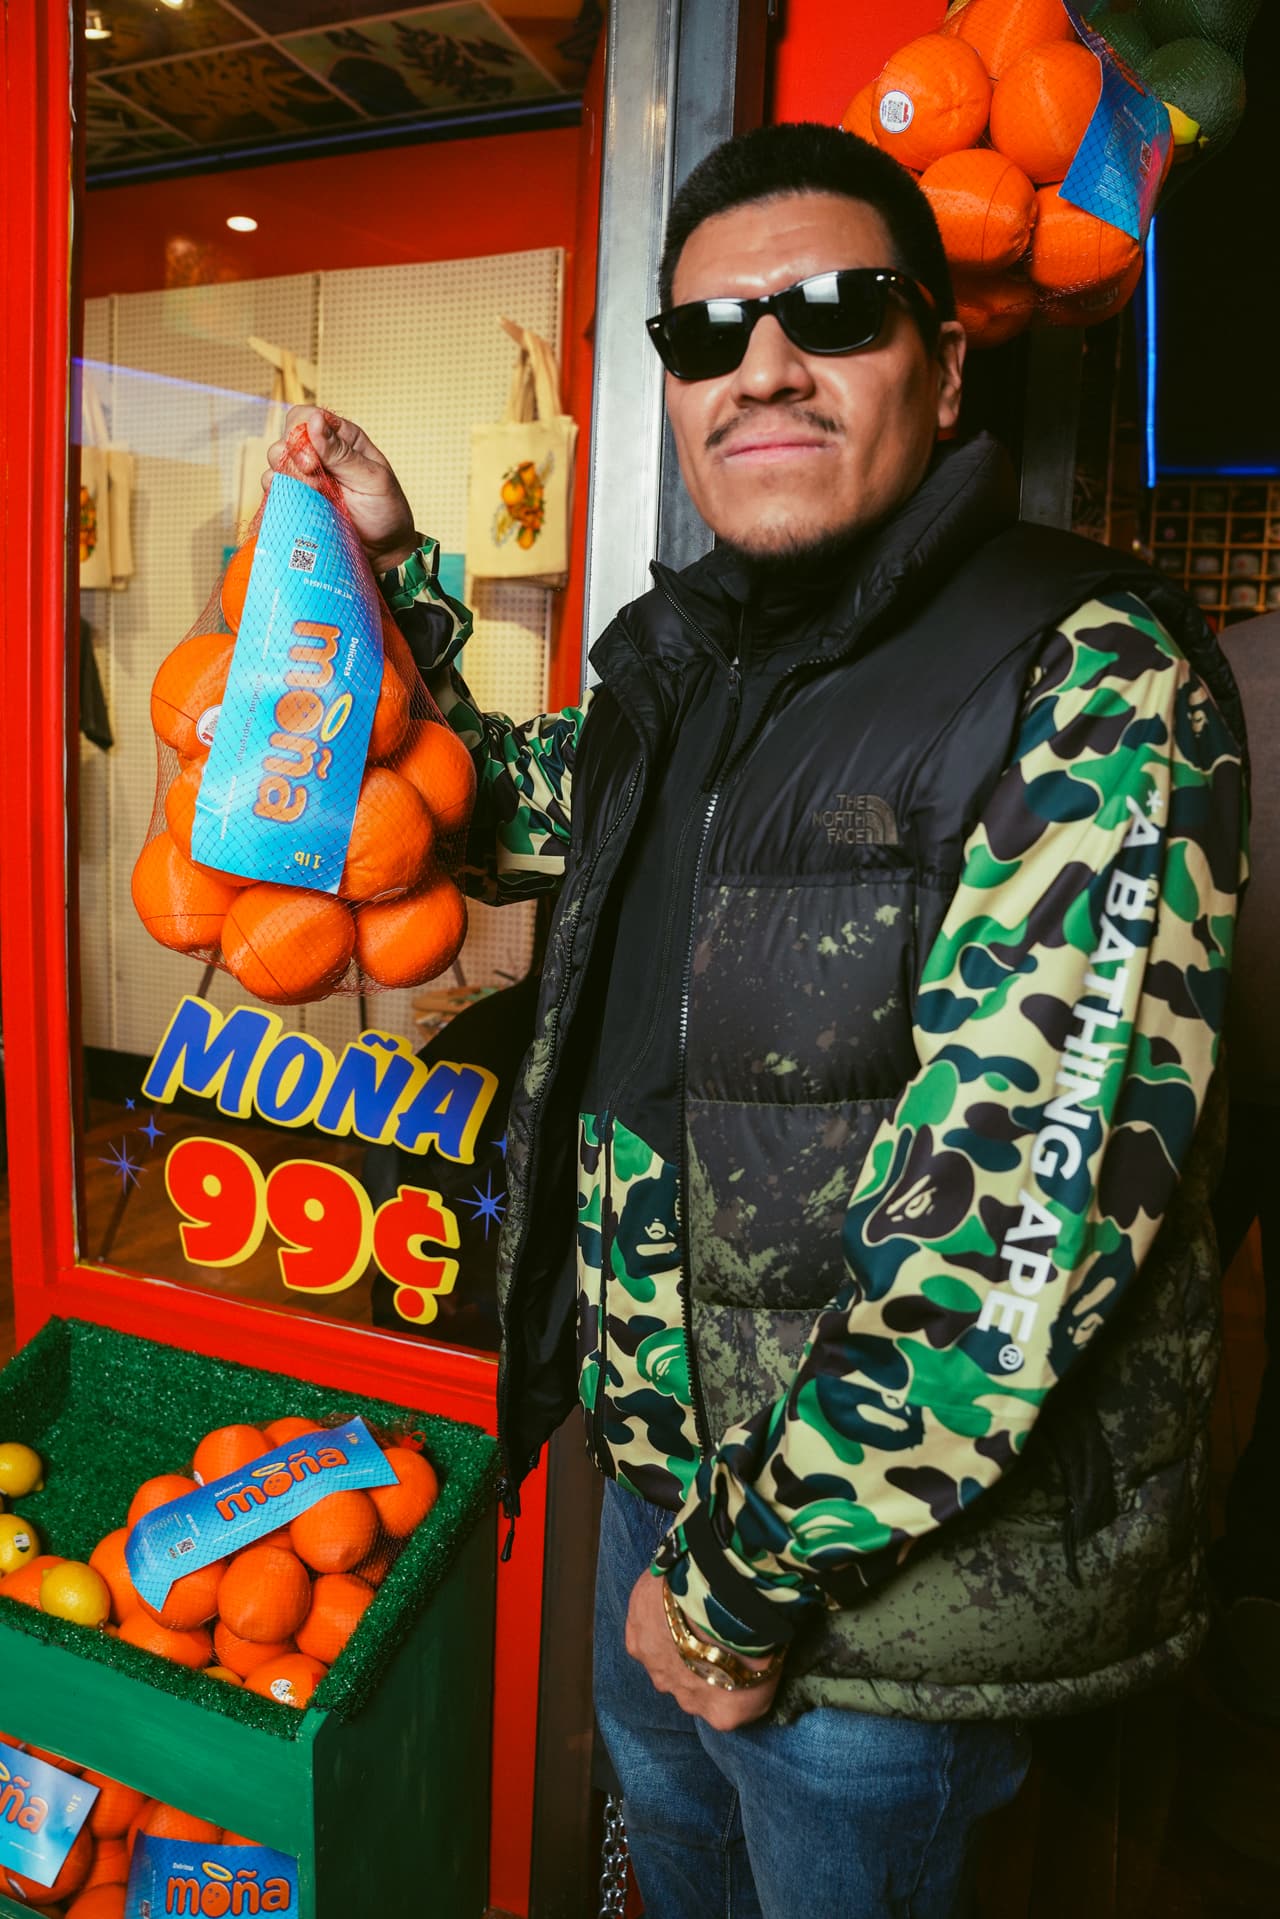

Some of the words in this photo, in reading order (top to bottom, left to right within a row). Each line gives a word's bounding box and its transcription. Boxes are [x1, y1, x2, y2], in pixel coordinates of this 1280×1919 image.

[253, 619, 343, 824] moña
[812, 810, 866, 827] NORTH
[827, 828, 866, 844] FACE
[836, 794, 866, 810] THE
[1029, 867, 1149, 1182] BATHING
[141, 994, 500, 1165] MOÑA
[164, 1136, 461, 1325] 99¢
[215, 1446, 348, 1522] moña
[0, 1775, 49, 1835] ña
[165, 1868, 292, 1919] moña
